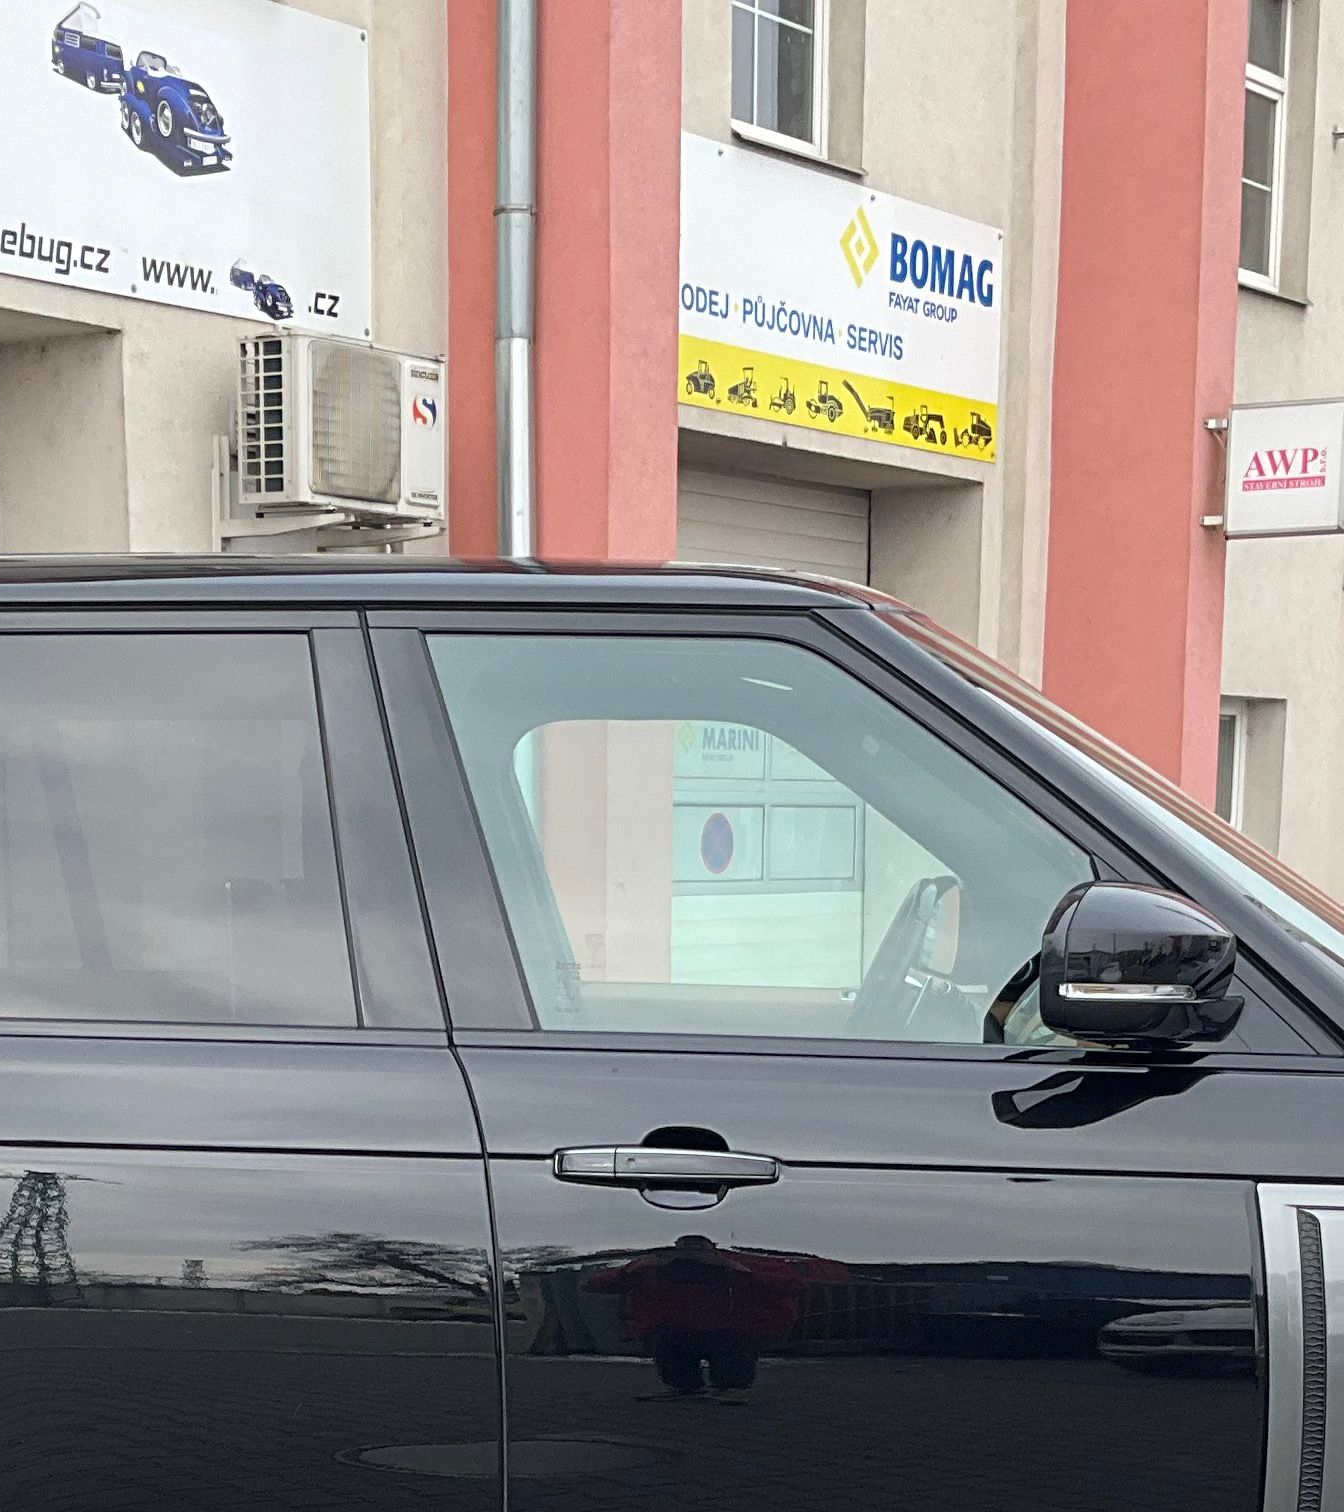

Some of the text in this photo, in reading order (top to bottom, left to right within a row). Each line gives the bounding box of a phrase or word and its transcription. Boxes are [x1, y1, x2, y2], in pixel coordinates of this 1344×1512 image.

[142, 257, 340, 318] www. .cz
[889, 232, 993, 307] BOMAG
[681, 283, 903, 360] ODEJ PŮJČOVNA SERVIS
[888, 292, 958, 323] FAYAT GROUP
[1243, 448, 1319, 477] AWP
[702, 727, 759, 751] MARINI
